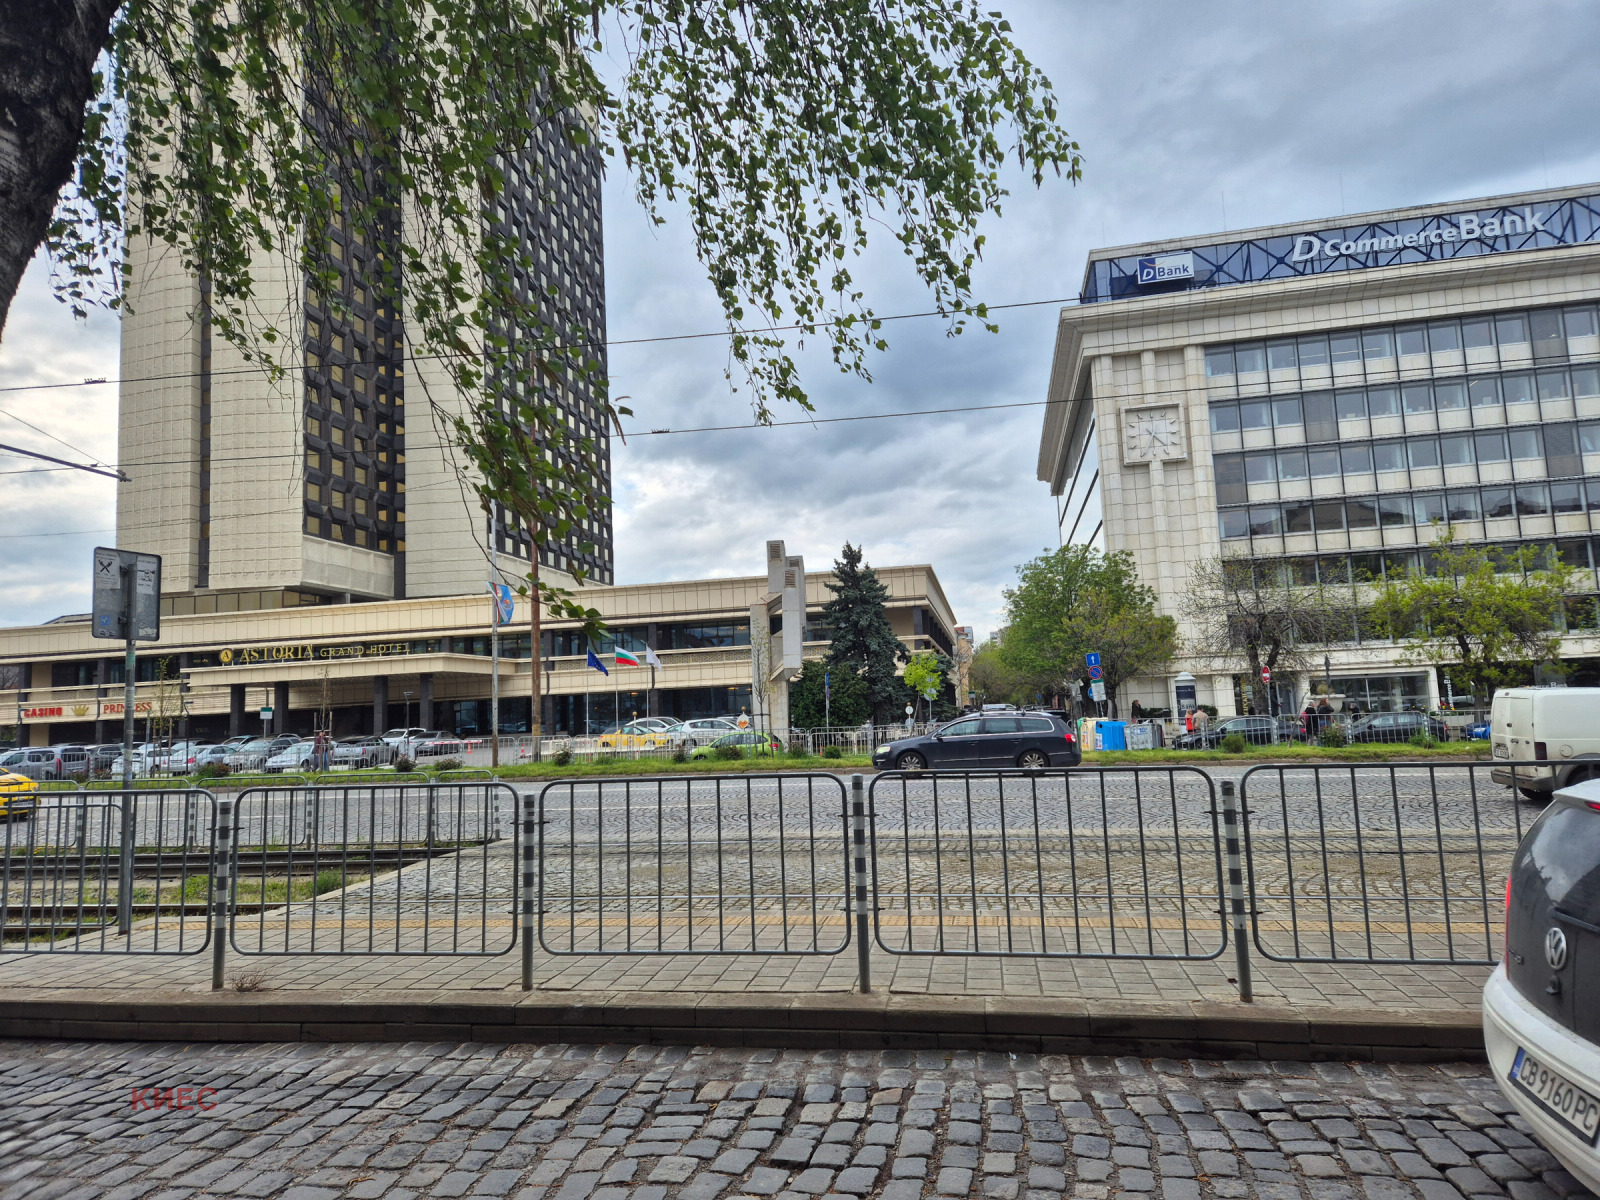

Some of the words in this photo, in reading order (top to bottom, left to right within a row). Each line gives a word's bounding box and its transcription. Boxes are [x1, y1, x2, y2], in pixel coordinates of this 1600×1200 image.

[1291, 236, 1321, 262] D
[1142, 268, 1154, 280] D
[1158, 264, 1190, 277] Bank
[239, 644, 315, 663] ASTORIA
[320, 646, 365, 657] GRAND
[370, 643, 411, 654] HOTEL
[24, 706, 63, 718] CASINO
[103, 702, 153, 714] PRINESS
